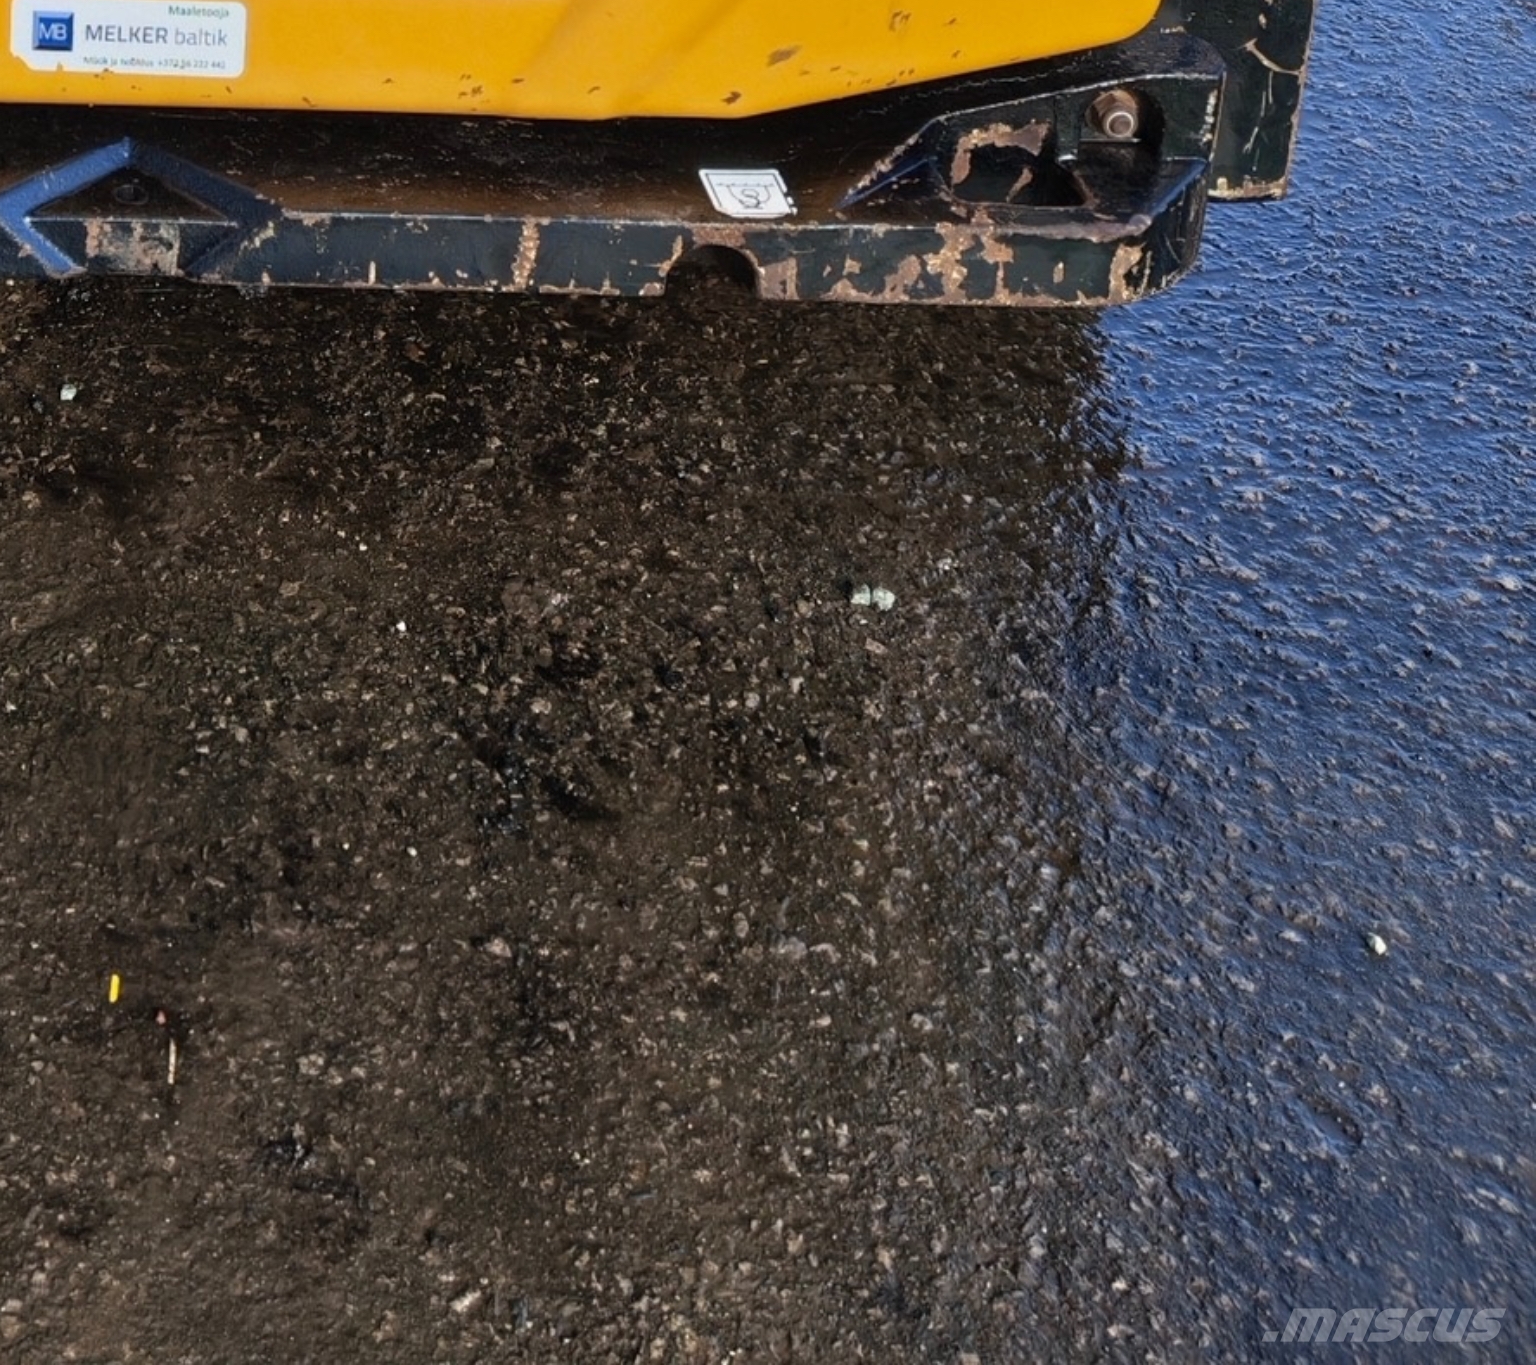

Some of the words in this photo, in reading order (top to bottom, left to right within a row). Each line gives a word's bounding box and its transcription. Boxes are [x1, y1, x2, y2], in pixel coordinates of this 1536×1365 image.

[39, 22, 67, 41] MB
[84, 23, 170, 45] MELKER
[174, 27, 229, 47] baltik
